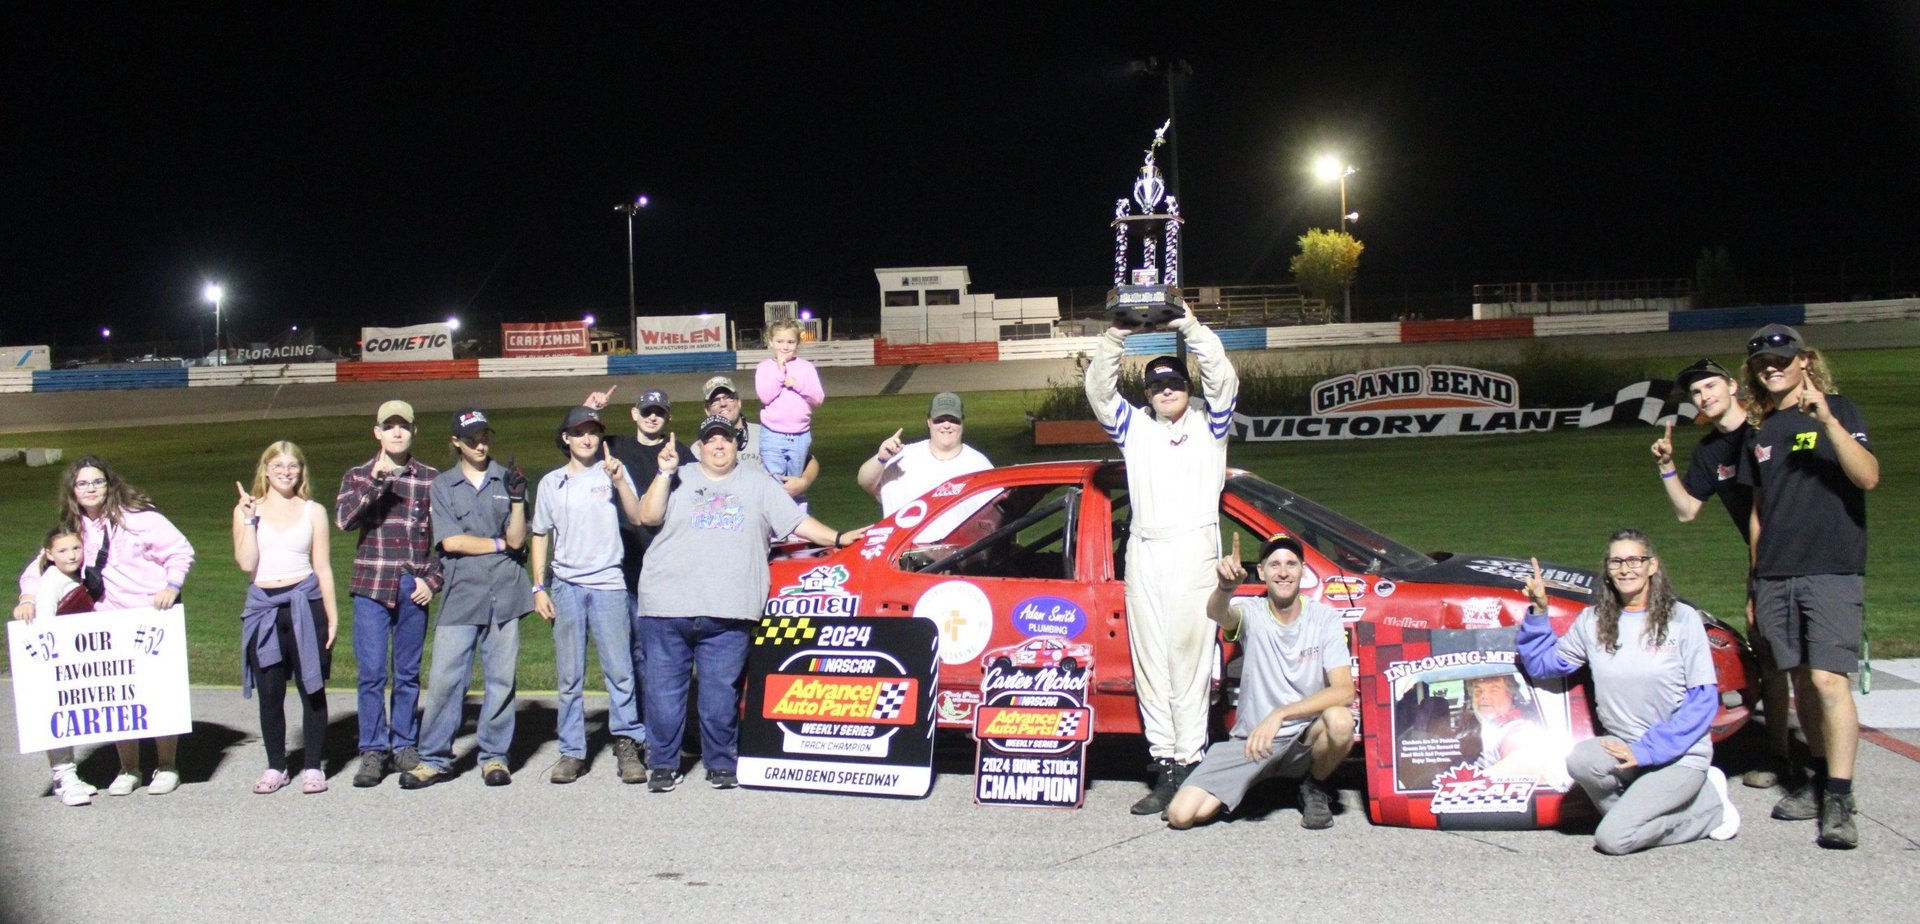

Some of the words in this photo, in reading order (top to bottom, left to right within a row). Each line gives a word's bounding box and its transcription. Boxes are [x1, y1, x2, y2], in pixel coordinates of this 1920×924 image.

[365, 334, 447, 352] COMETIC
[509, 334, 580, 346] CRAFTSMAN
[640, 326, 721, 345] WHELEN
[237, 344, 314, 359] FLORACING
[1316, 370, 1421, 408] GRAND
[1430, 370, 1513, 404] BEND
[1252, 414, 1447, 438] VICTORY
[1458, 409, 1582, 433] LANE
[1792, 431, 1818, 451] 33
[1019, 603, 1045, 621] Adam
[1048, 605, 1076, 623] Smith
[817, 626, 871, 647] 2024
[1028, 623, 1068, 635] PLUMBING
[75, 631, 112, 653] OUR
[133, 624, 165, 656] #52
[55, 659, 136, 682] FAVOURITE
[825, 658, 876, 674] NASCAR
[1384, 663, 1408, 682] IN
[1410, 651, 1519, 673] LOVING-ME
[784, 679, 872, 700] Advance
[981, 667, 1034, 691] Carter
[1034, 668, 1089, 692] Nichol
[58, 685, 116, 707] DRIVER
[122, 684, 135, 700] IS
[1022, 696, 1058, 707] NASCAR
[771, 698, 818, 715] Auto
[818, 700, 867, 718] Parts
[995, 710, 1055, 725] Advance
[50, 704, 148, 738] CARTER
[801, 722, 840, 736] WEEKLY
[840, 725, 875, 738] SERIES
[985, 722, 1017, 735] Auto
[1017, 723, 1054, 736] Parts
[800, 740, 826, 750] TRACK
[827, 741, 872, 752] CHAMPION
[1005, 739, 1032, 748] WEEKLY
[1032, 739, 1058, 748] SERIES
[765, 767, 805, 782] GRAND
[806, 770, 836, 783] BEND
[837, 771, 900, 787] SPEEDWAY
[982, 758, 1010, 772] 2024
[1012, 758, 1041, 774] BONE
[1043, 759, 1078, 776] STOCK
[980, 775, 1077, 803] CHAMPION
[1440, 779, 1533, 798] JCAR
